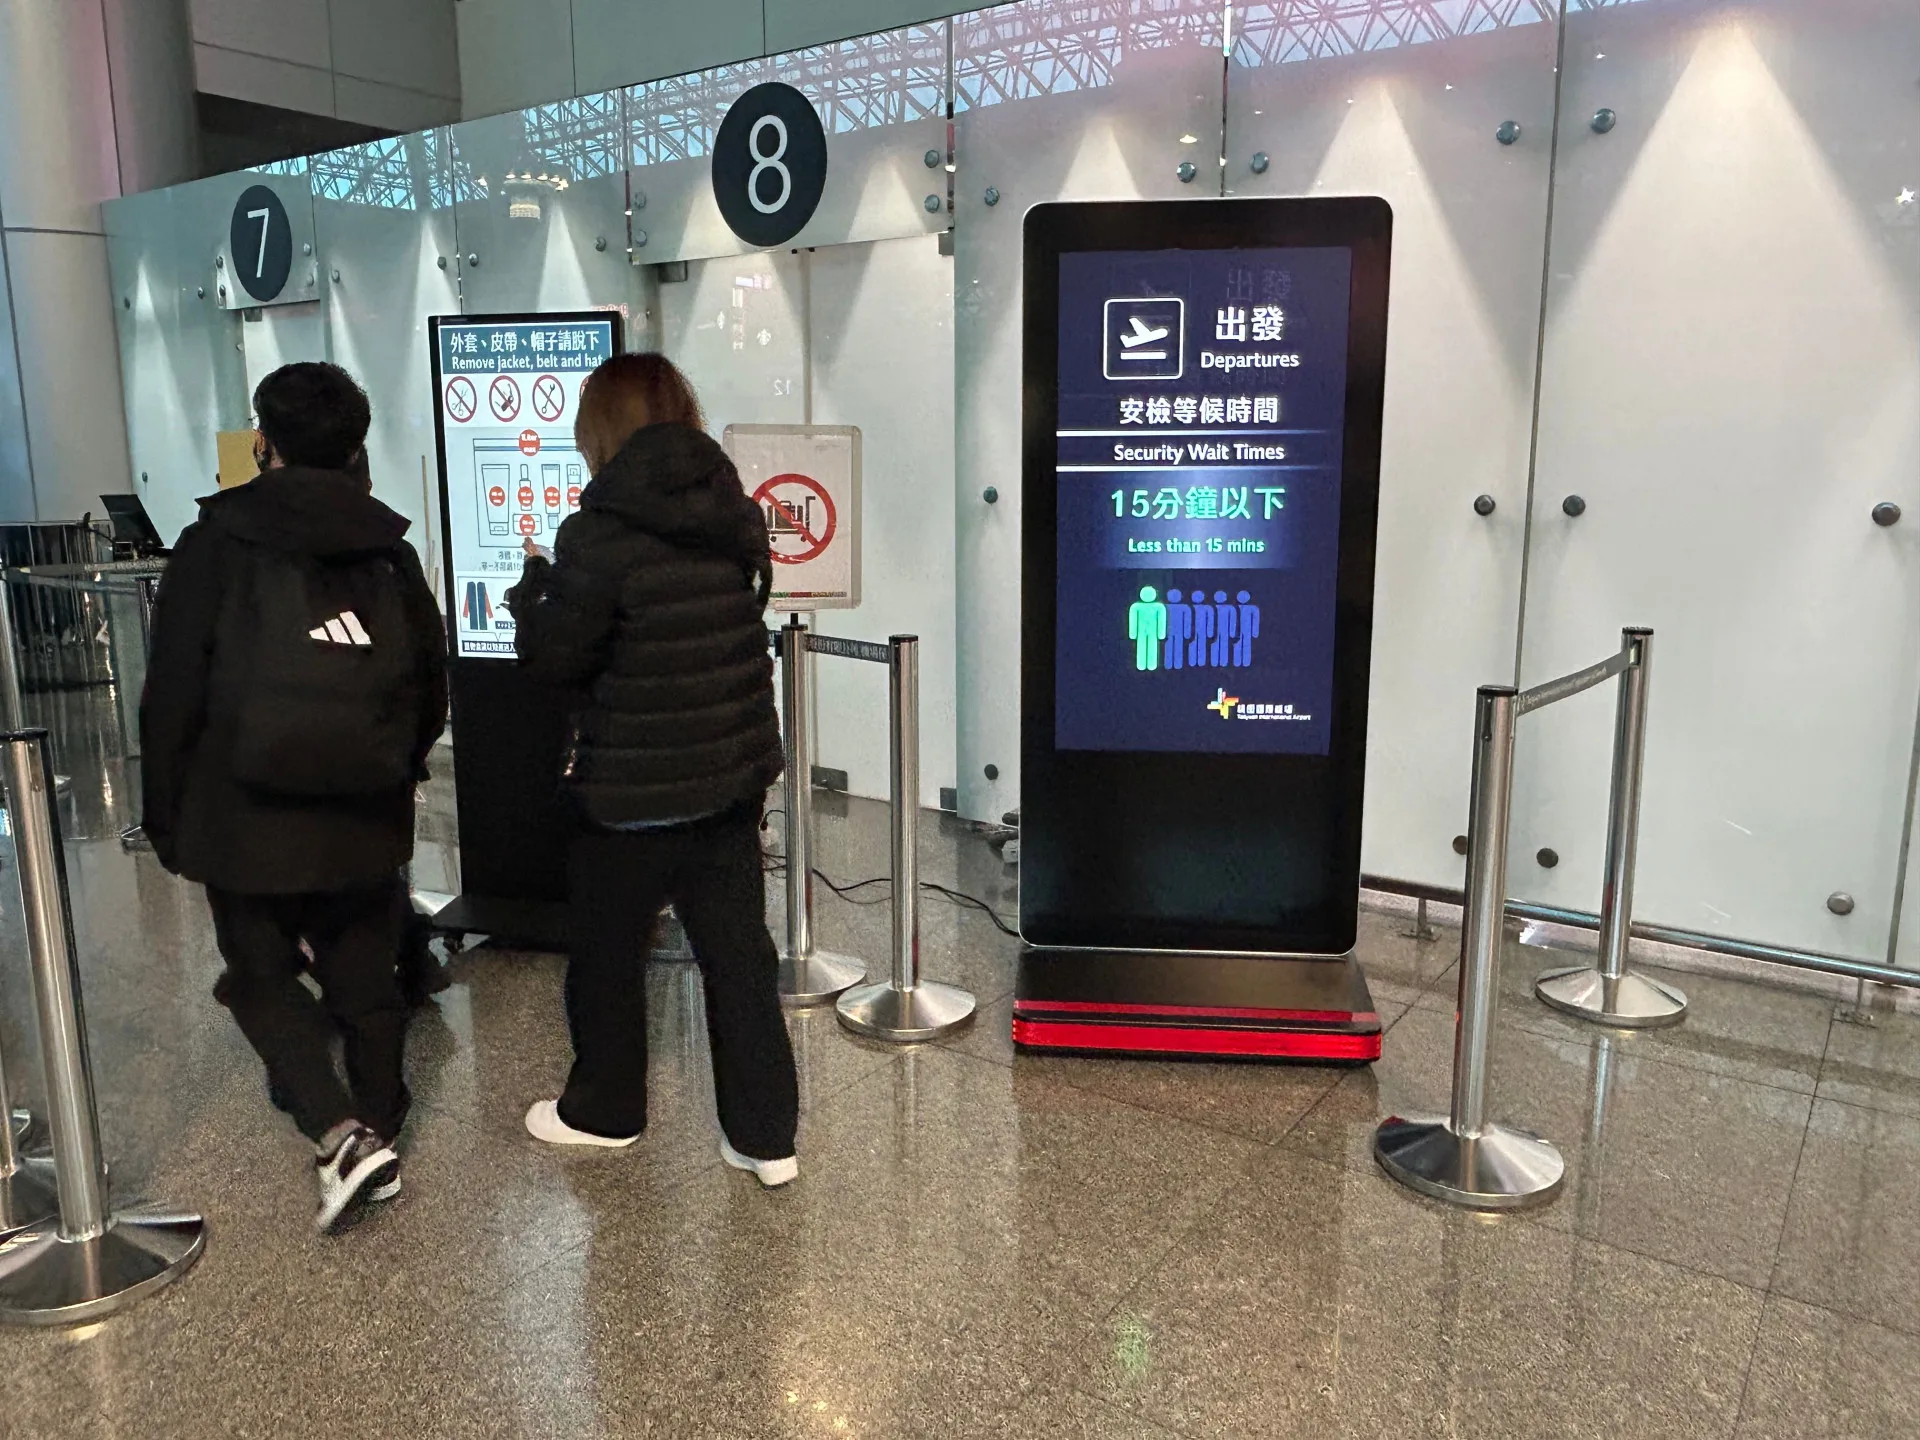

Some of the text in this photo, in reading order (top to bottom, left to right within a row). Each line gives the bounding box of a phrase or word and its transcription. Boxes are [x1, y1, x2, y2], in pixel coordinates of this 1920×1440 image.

[748, 114, 791, 214] 8
[247, 207, 270, 279] 7
[1215, 305, 1284, 342] 出發
[452, 356, 495, 370] Remove
[497, 355, 534, 372] jacket,
[536, 354, 558, 368] belt
[561, 353, 581, 368] and
[1201, 352, 1299, 372] Departures
[1119, 397, 1278, 424] 安檢等候時間
[1114, 443, 1285, 465] Security Wait Times
[1111, 486, 1285, 520] 15分鐘以下
[1128, 538, 1265, 552] Less than 15 mins
